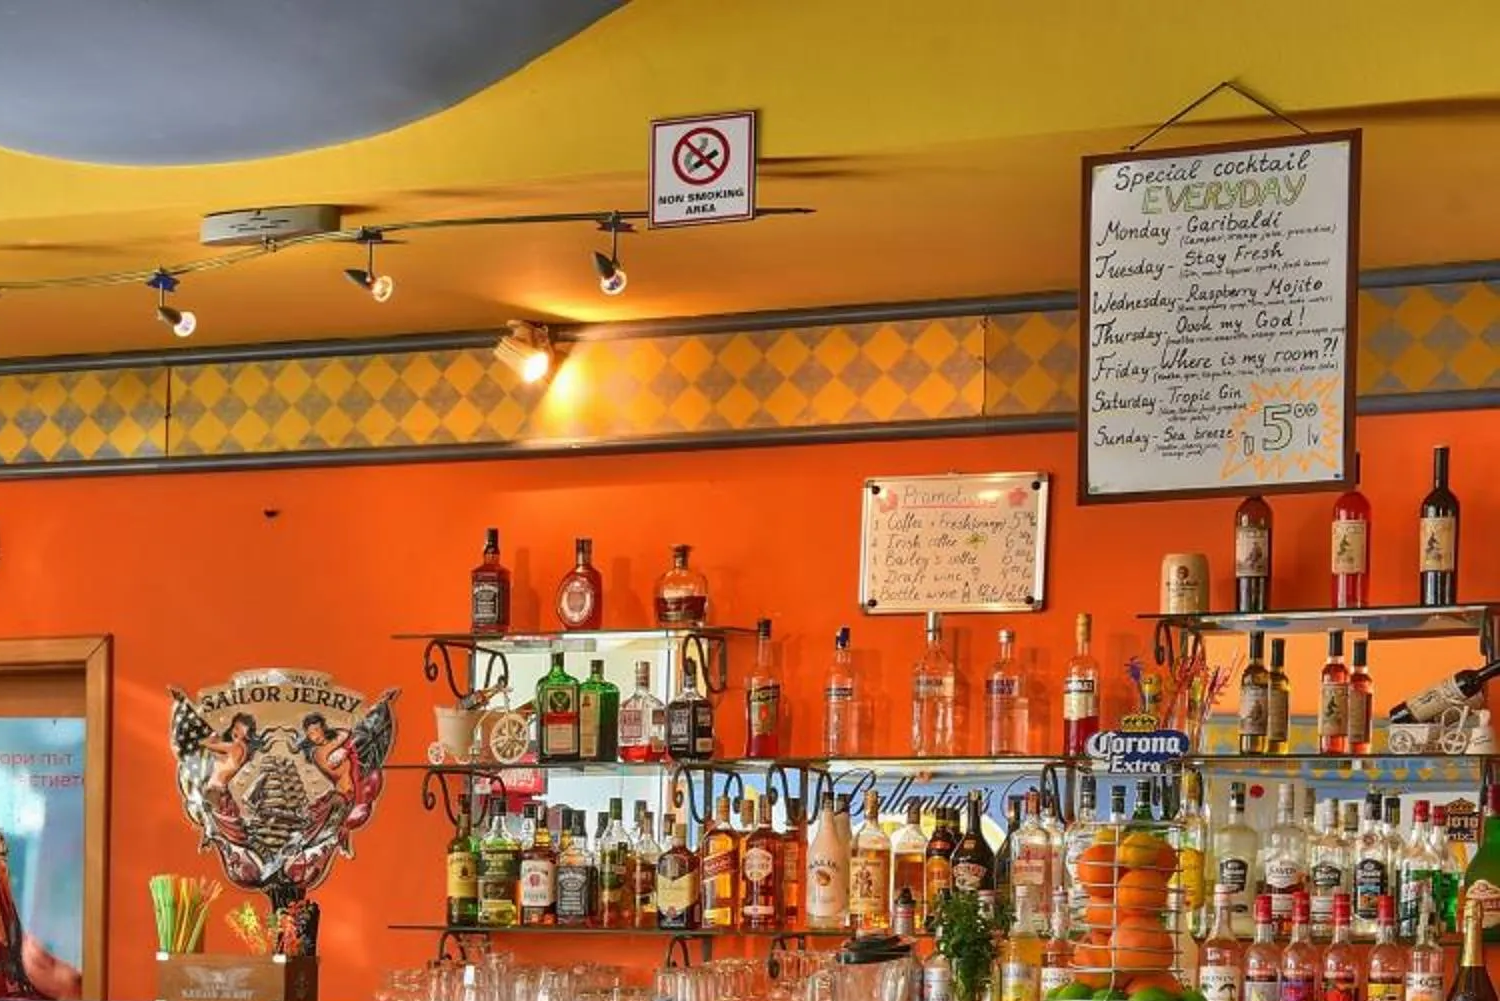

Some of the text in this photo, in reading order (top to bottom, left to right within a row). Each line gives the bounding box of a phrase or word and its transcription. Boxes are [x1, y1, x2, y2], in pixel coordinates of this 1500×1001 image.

[1115, 150, 1311, 192] Special cocktail
[658, 188, 744, 205] NON SMOKING
[1141, 173, 1307, 214] EVERYDAY
[685, 204, 716, 215] AREA
[1187, 211, 1282, 233] Garibaldi
[1183, 250, 1226, 268] Stay
[1233, 242, 1283, 261] Fresh
[1187, 284, 1257, 303] Raspberry
[1265, 276, 1323, 297] Mojito
[1219, 319, 1243, 333] my
[1160, 348, 1213, 369] Where
[1221, 352, 1236, 365] is
[1242, 354, 1267, 369] my
[1167, 385, 1211, 406] Tropic
[1219, 384, 1242, 400] Gin
[1164, 427, 1186, 443] Sea
[1195, 428, 1234, 440] breeze
[201, 686, 362, 714] SAILOR JERRY
[1084, 731, 1182, 761] Corona
[1110, 755, 1163, 774] Extra
